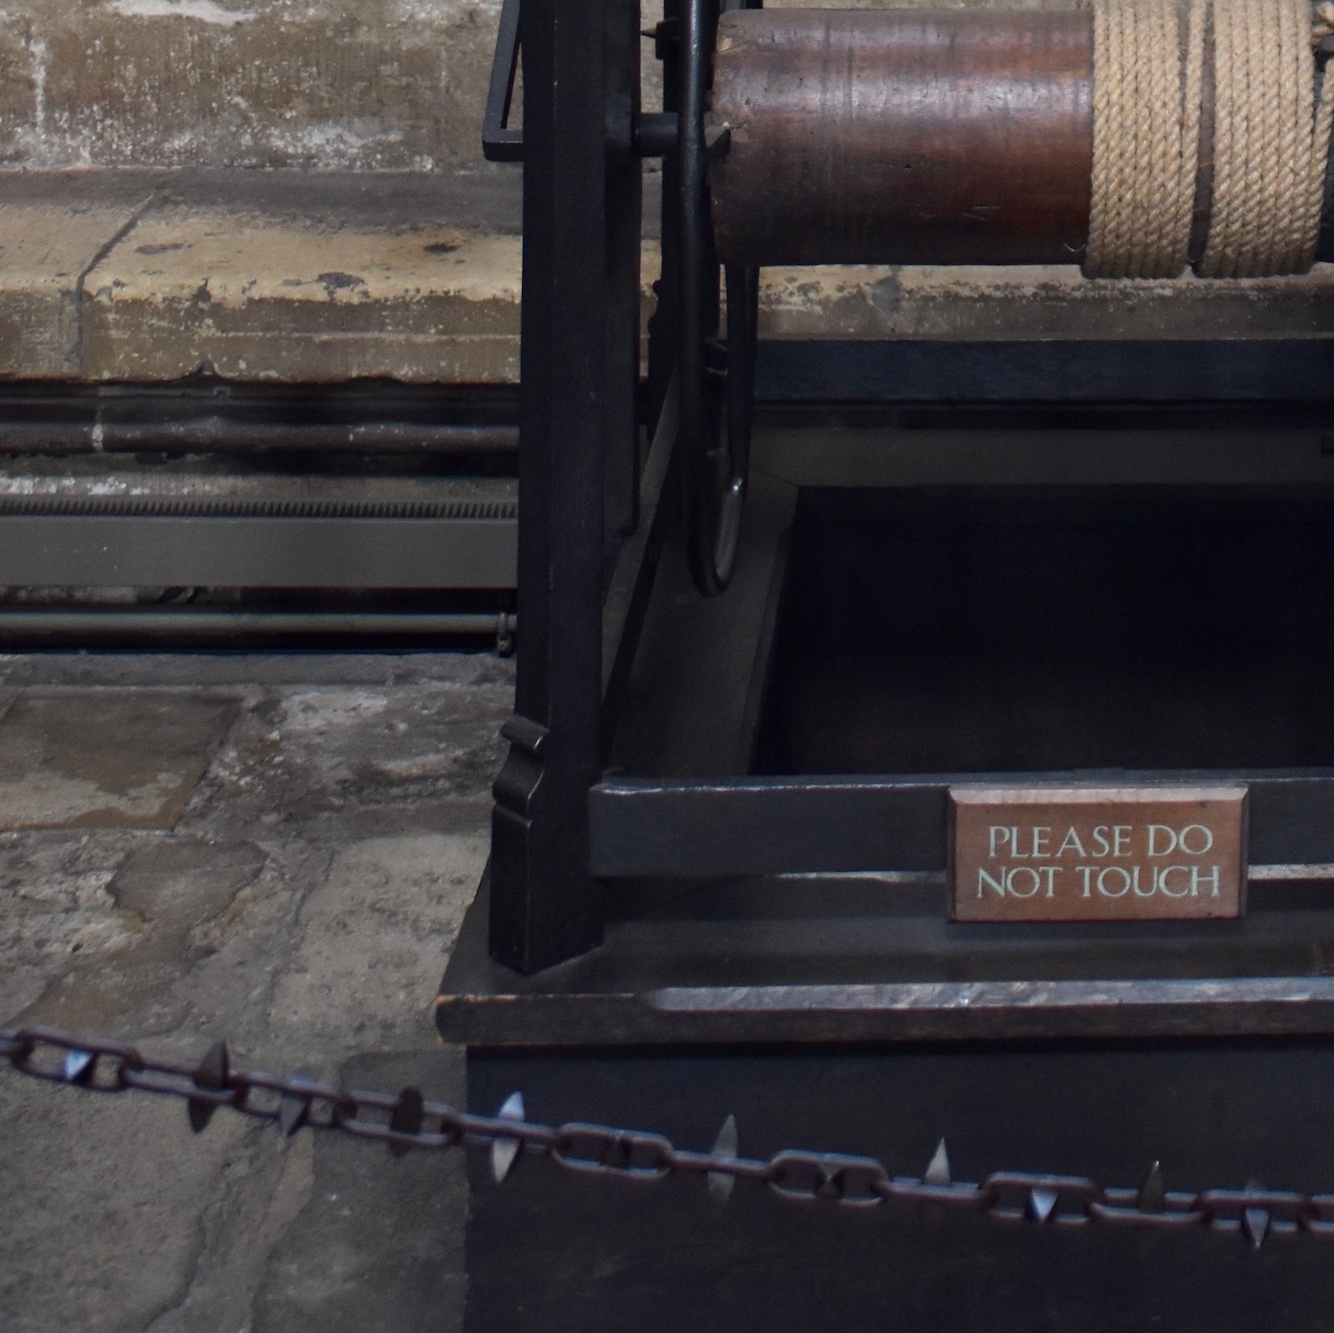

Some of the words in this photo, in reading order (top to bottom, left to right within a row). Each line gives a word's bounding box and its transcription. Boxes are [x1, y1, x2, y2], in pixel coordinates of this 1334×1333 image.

[988, 825, 1133, 858] PLEASE
[1147, 824, 1213, 857] DO
[976, 865, 1063, 899] NOT
[1075, 865, 1220, 899] TOUCH
